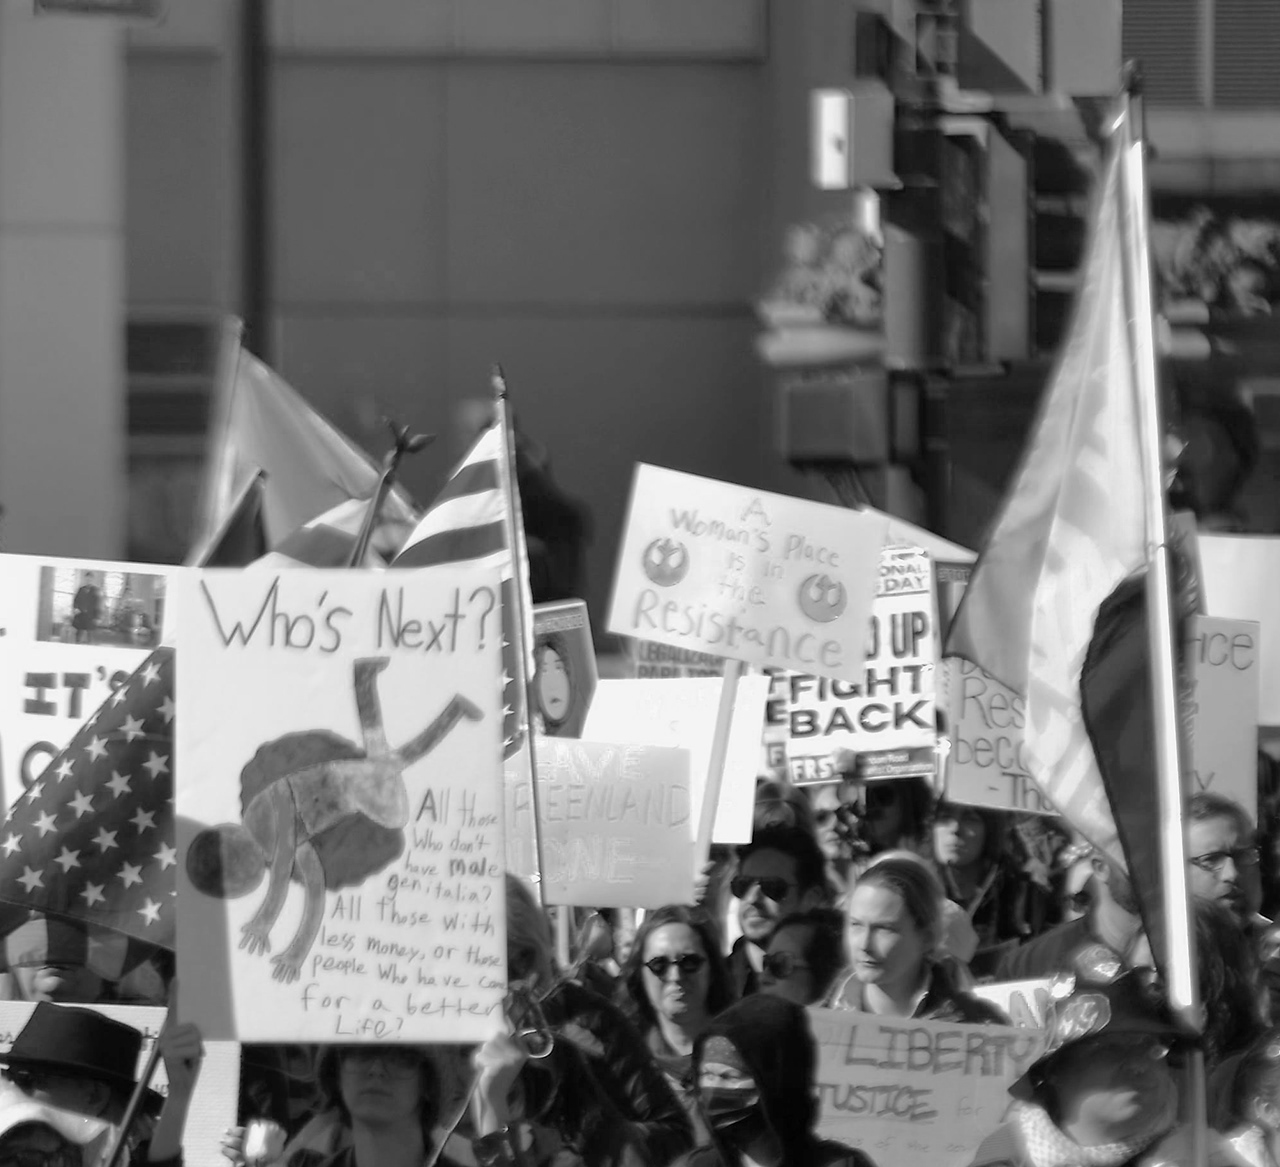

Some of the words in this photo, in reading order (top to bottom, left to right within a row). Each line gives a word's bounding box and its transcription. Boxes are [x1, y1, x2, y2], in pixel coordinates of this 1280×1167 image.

[739, 496, 773, 527] A
[782, 532, 841, 569] Place
[198, 574, 354, 653] Who's
[376, 584, 498, 654] Next?
[632, 587, 846, 670] Resistance
[889, 610, 931, 660] UP
[788, 662, 934, 706] FIGHT
[789, 698, 935, 740] BACK
[414, 787, 451, 826] All
[449, 828, 492, 853] don't
[404, 850, 440, 877] have
[330, 894, 363, 922] All
[320, 924, 357, 953] less
[417, 966, 470, 990] have
[299, 982, 352, 1013] for
[405, 991, 502, 1020] better
